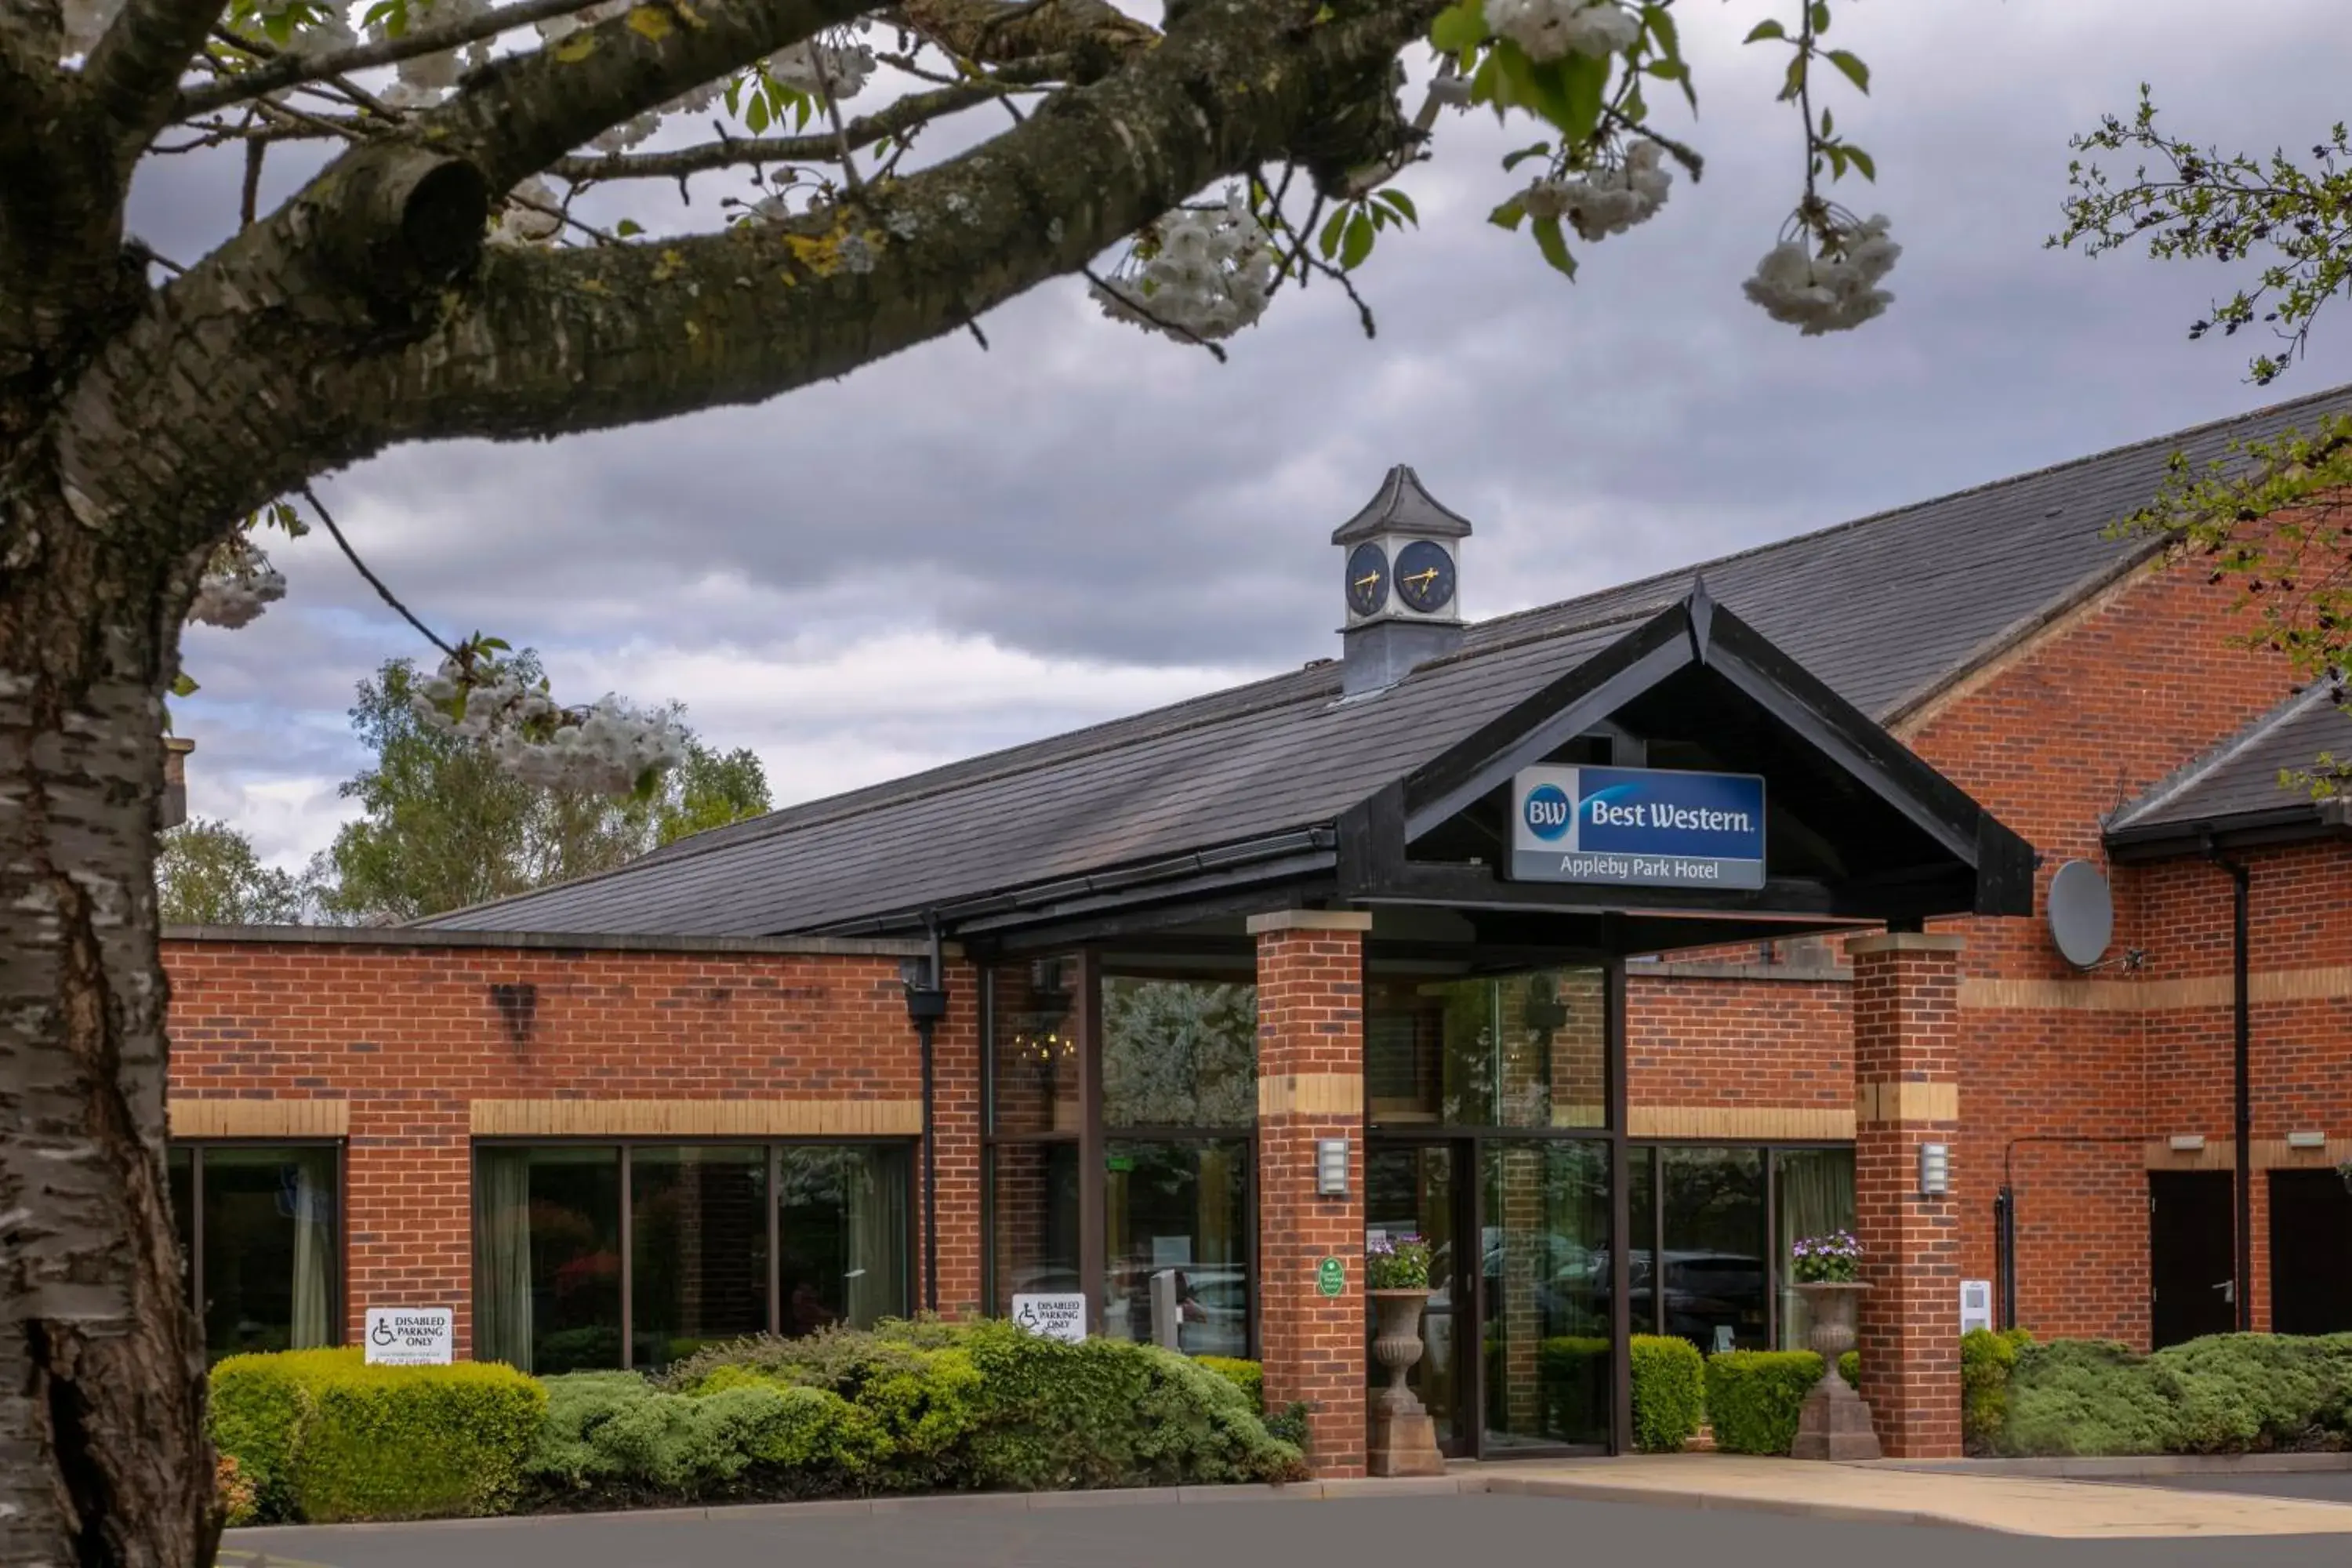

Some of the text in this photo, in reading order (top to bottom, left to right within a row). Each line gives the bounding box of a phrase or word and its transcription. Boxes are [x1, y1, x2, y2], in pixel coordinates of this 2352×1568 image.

[1530, 801, 1566, 825] BW
[1592, 800, 1646, 827] Best
[1560, 855, 1719, 879] Appleby Park Hotel
[1037, 1301, 1080, 1310] DISABLED
[1040, 1311, 1078, 1319] PARKING
[395, 1317, 445, 1326] DISABLED
[1047, 1320, 1069, 1329] ONLY
[397, 1327, 443, 1337] PARKING
[405, 1337, 434, 1346] ONLY
